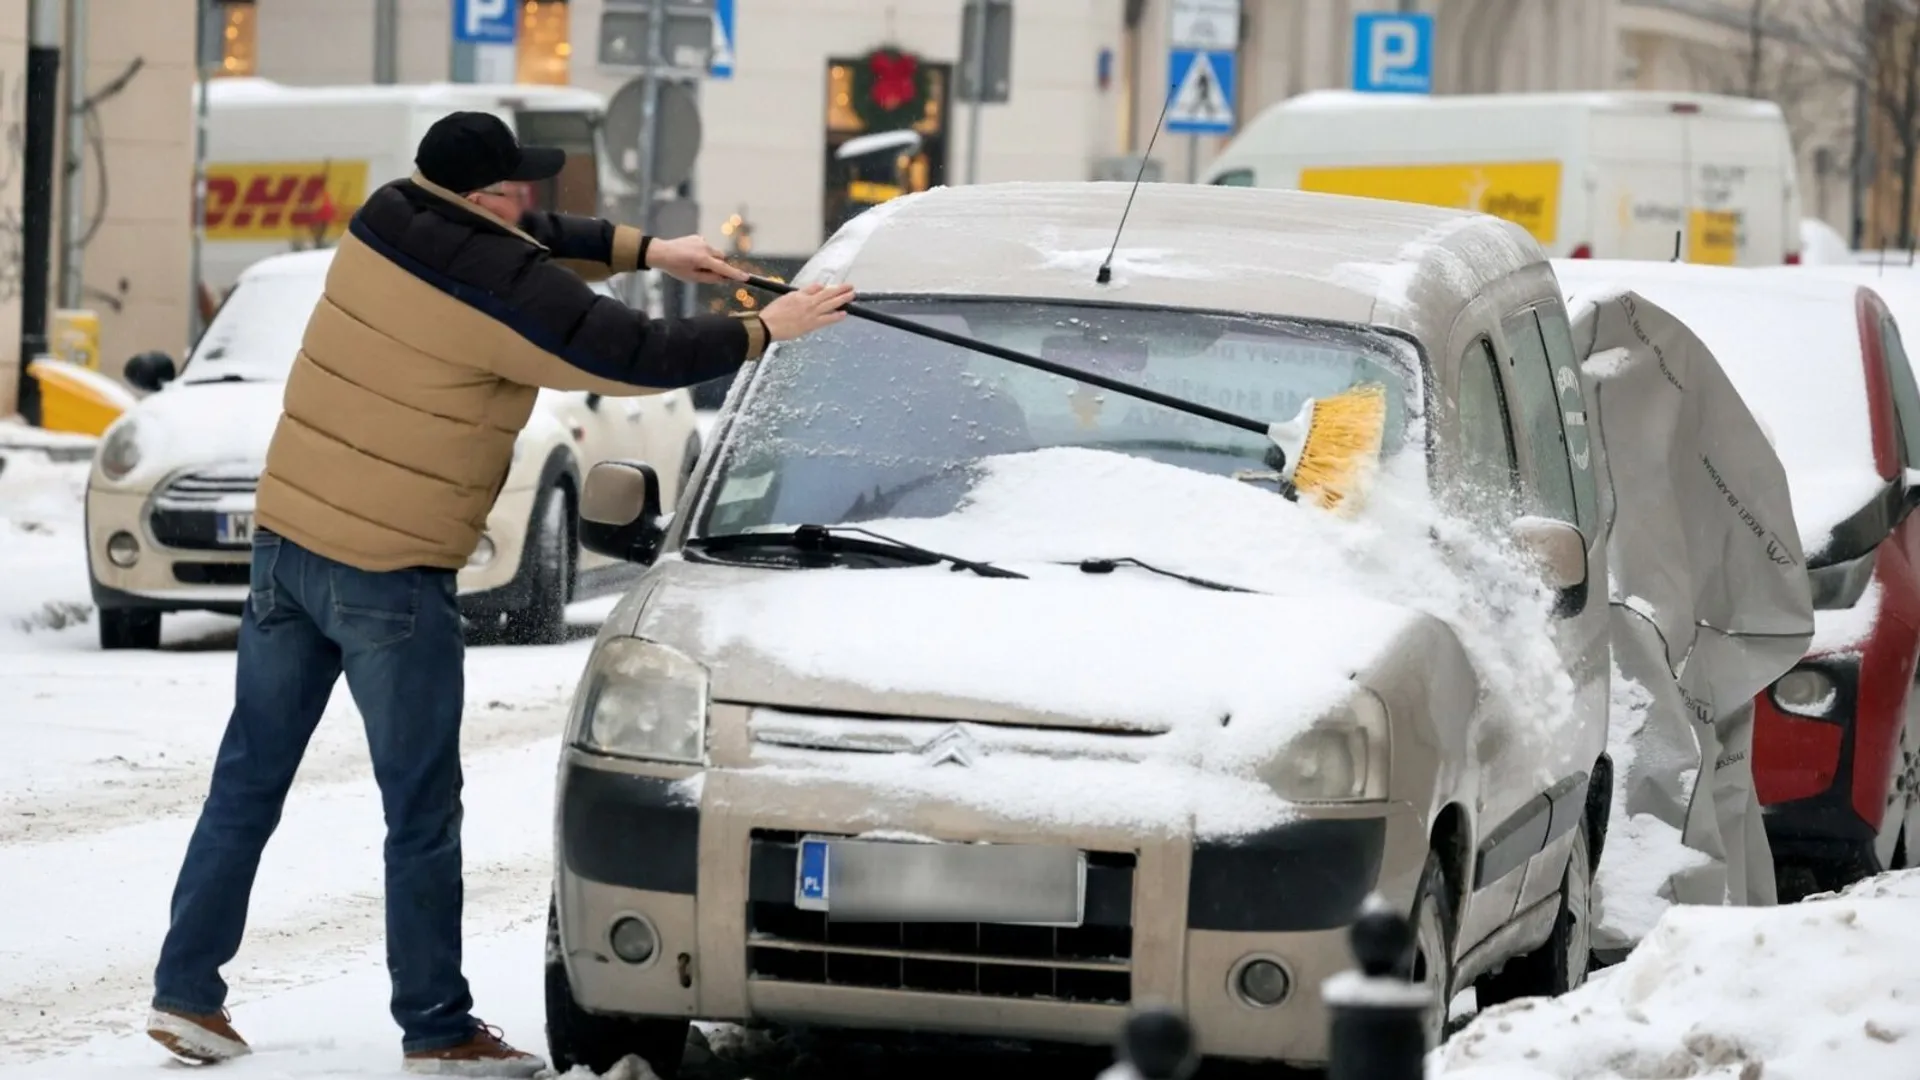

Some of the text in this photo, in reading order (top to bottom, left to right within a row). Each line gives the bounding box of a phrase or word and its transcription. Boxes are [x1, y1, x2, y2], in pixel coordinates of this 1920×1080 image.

[466, 0, 505, 34] P
[1371, 21, 1418, 84] P
[206, 174, 333, 228] DHL
[804, 876, 821, 891] PL
